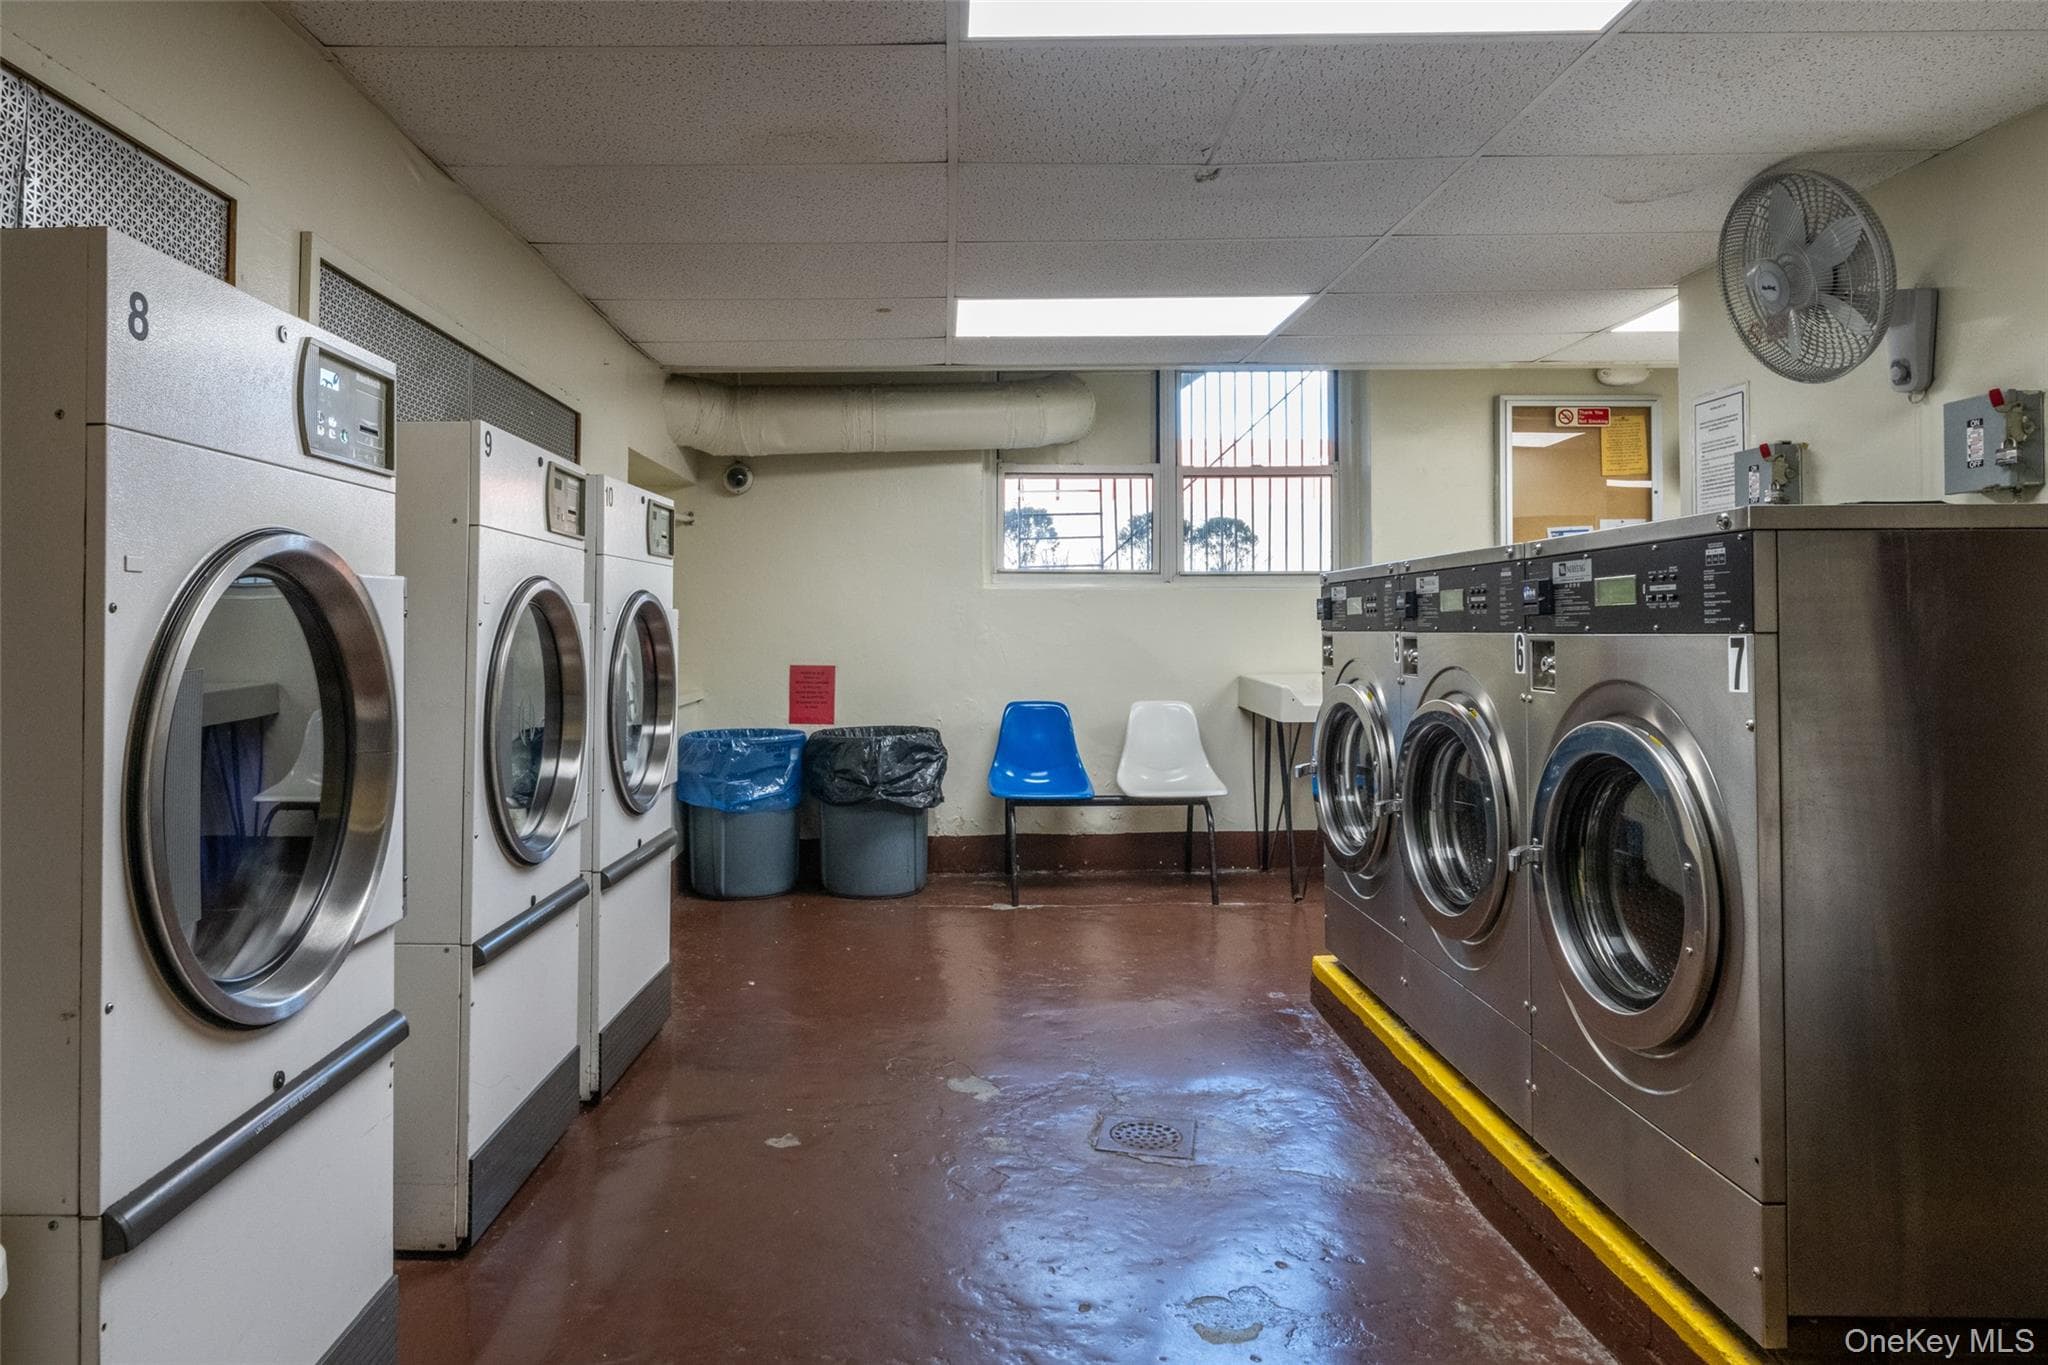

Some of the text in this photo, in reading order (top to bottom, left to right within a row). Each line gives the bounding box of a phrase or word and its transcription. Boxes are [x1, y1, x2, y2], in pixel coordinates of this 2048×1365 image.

[128, 291, 149, 341] 8
[1970, 419, 1981, 427] ON
[484, 430, 492, 458] 9
[1969, 460, 1982, 468] OFF
[605, 486, 614, 507] 10
[1394, 632, 1400, 662] 5
[1516, 634, 1524, 672] 6
[1730, 637, 1745, 690] 7
